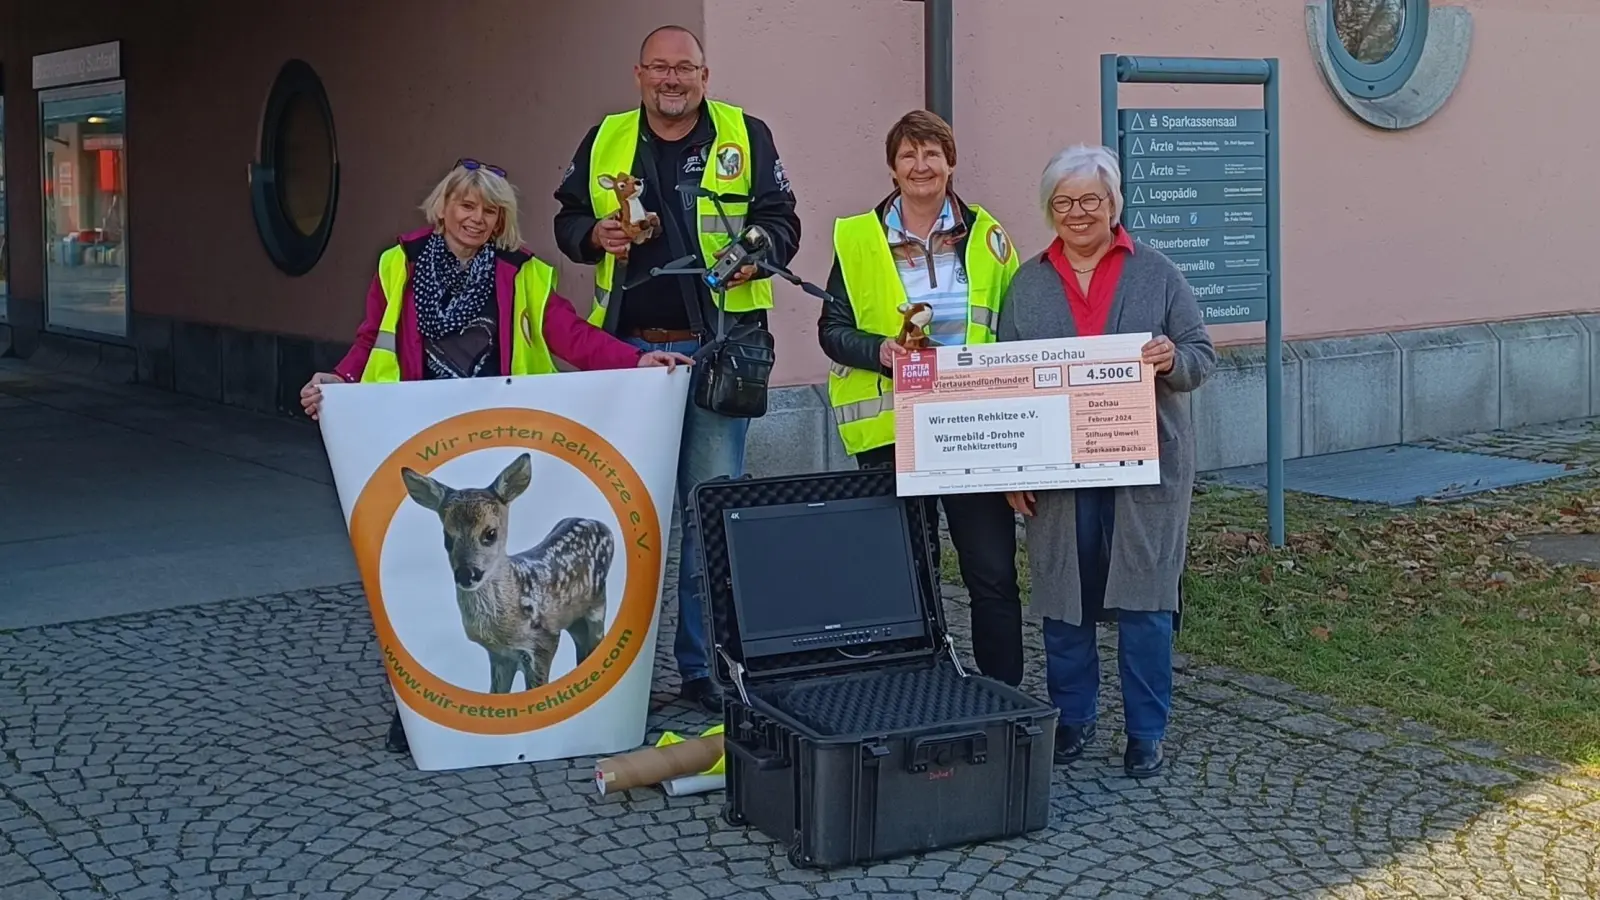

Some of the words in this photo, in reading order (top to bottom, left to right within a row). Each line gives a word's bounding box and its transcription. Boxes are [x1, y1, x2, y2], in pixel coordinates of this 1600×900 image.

[1162, 115, 1237, 130] Sparkassensaal
[1150, 138, 1174, 152] Ärzte
[1150, 162, 1174, 176] Ärzte
[1149, 187, 1198, 201] Logopädie
[1150, 214, 1180, 225] Notare
[1149, 237, 1210, 250] Steuerberater
[1177, 260, 1215, 272] sanwälte
[1191, 284, 1225, 298] tsprüfer
[1206, 305, 1250, 318] Reisebüro
[979, 352, 1038, 367] Sparkasse
[1041, 349, 1086, 361] Dachau
[902, 363, 929, 371] STIFTER
[1087, 367, 1134, 380] 4.500€
[902, 370, 929, 378] FORUM
[1038, 373, 1058, 382] EUR
[933, 376, 1029, 389] Viertausendfünfhundert
[1088, 400, 1119, 408] Dachau
[929, 415, 945, 425] Wir
[947, 413, 975, 424] retten
[977, 411, 1019, 422] Rehkitze
[1020, 410, 1039, 420] e.V.
[1088, 415, 1113, 423] Februar
[934, 432, 985, 443] Wärmebild
[1085, 431, 1112, 439] Stiftung
[1113, 429, 1139, 437] Umwelt
[942, 445, 955, 453] zur
[957, 441, 1018, 451] Rehkitzrettung
[1085, 447, 1120, 455] Sparkasse
[416, 436, 459, 462] Wir
[468, 425, 543, 443] retten
[551, 431, 631, 504] Rehkitze
[629, 510, 651, 559] e.V.
[730, 512, 740, 520] 4K
[384, 628, 632, 719] www.wir-retten-rehkitze.com
